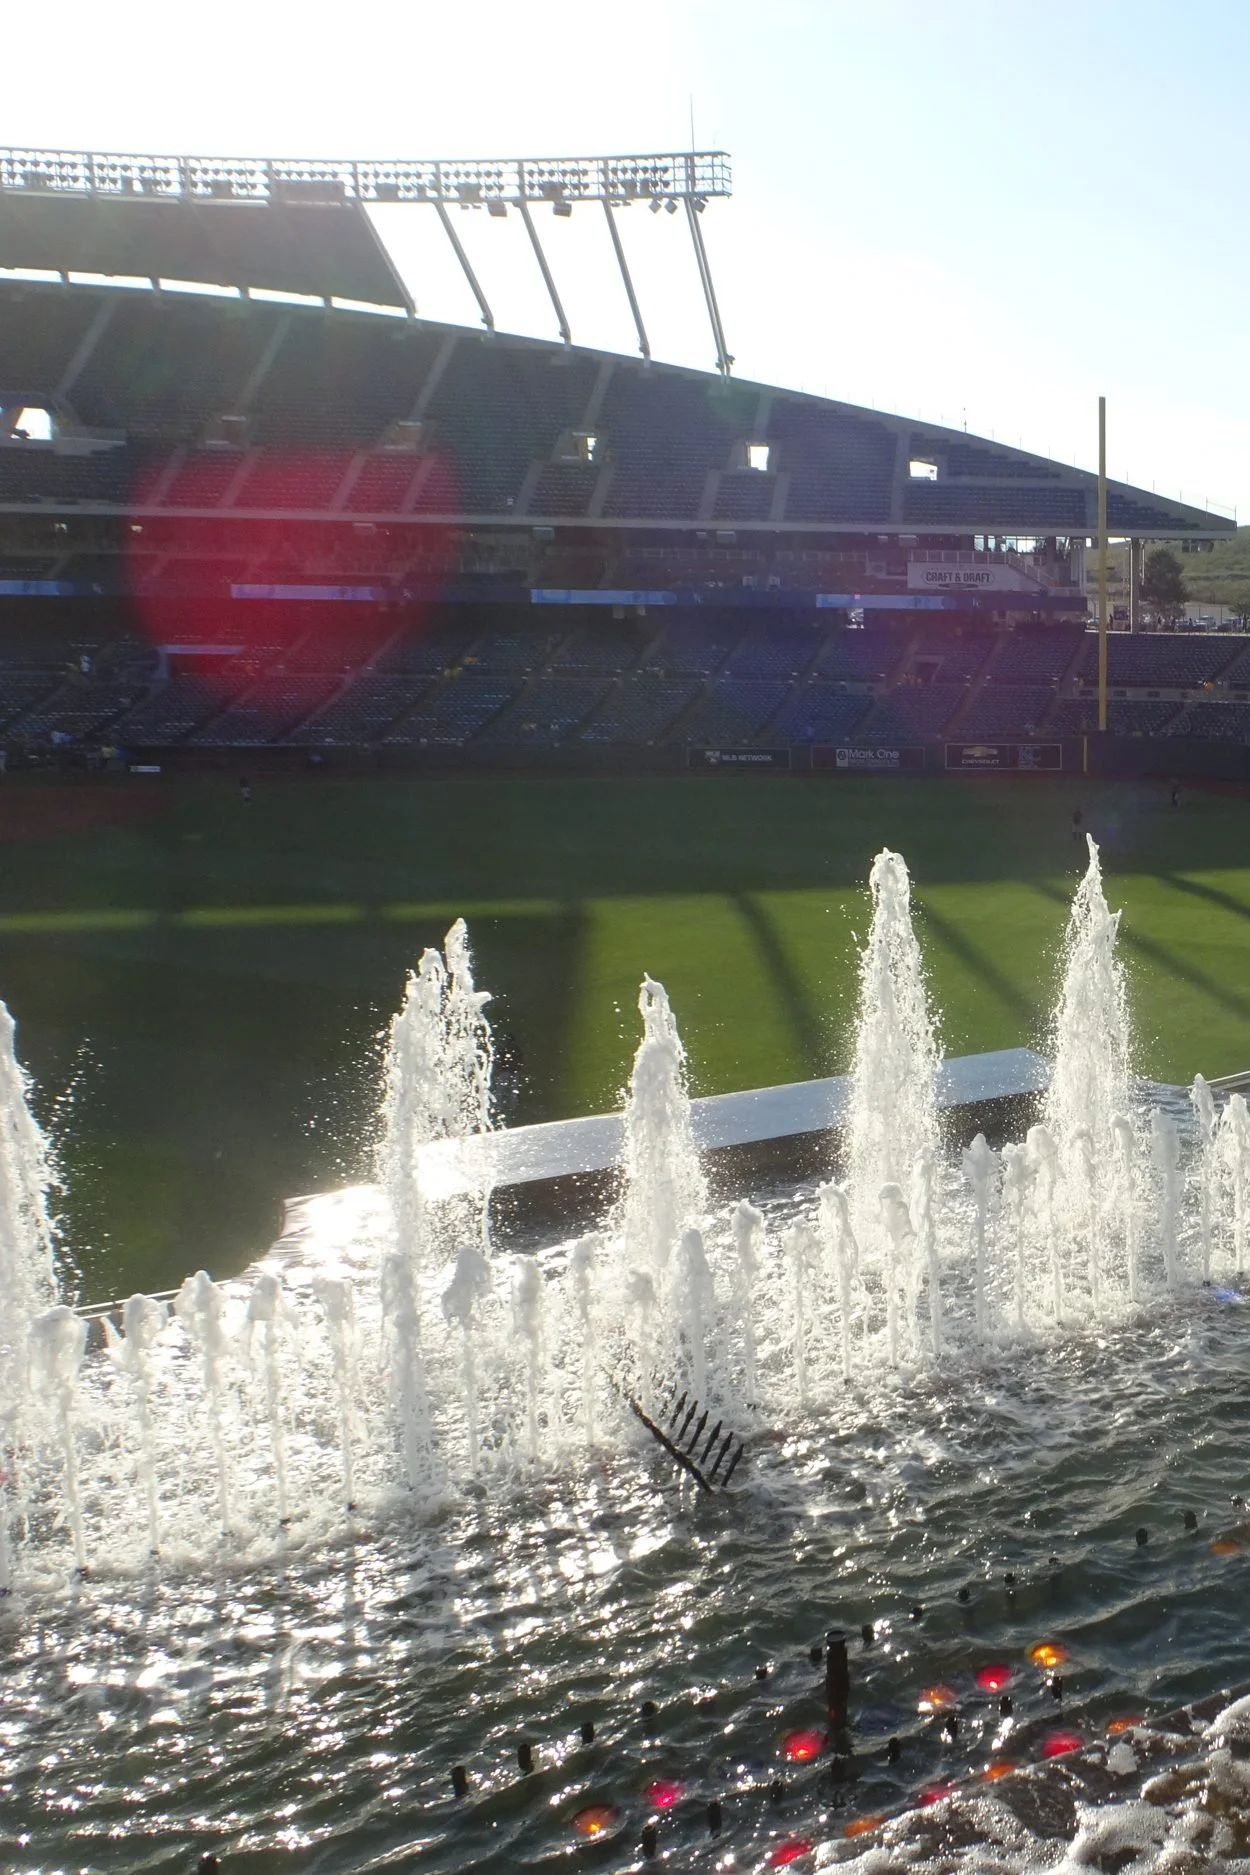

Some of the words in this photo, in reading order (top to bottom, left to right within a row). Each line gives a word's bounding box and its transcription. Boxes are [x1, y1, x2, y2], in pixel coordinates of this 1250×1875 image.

[926, 571, 953, 583] CRAFT
[963, 572, 990, 584] DRAFT
[738, 754, 772, 762] NETWORK
[849, 749, 875, 759] Mark
[877, 749, 900, 759] One
